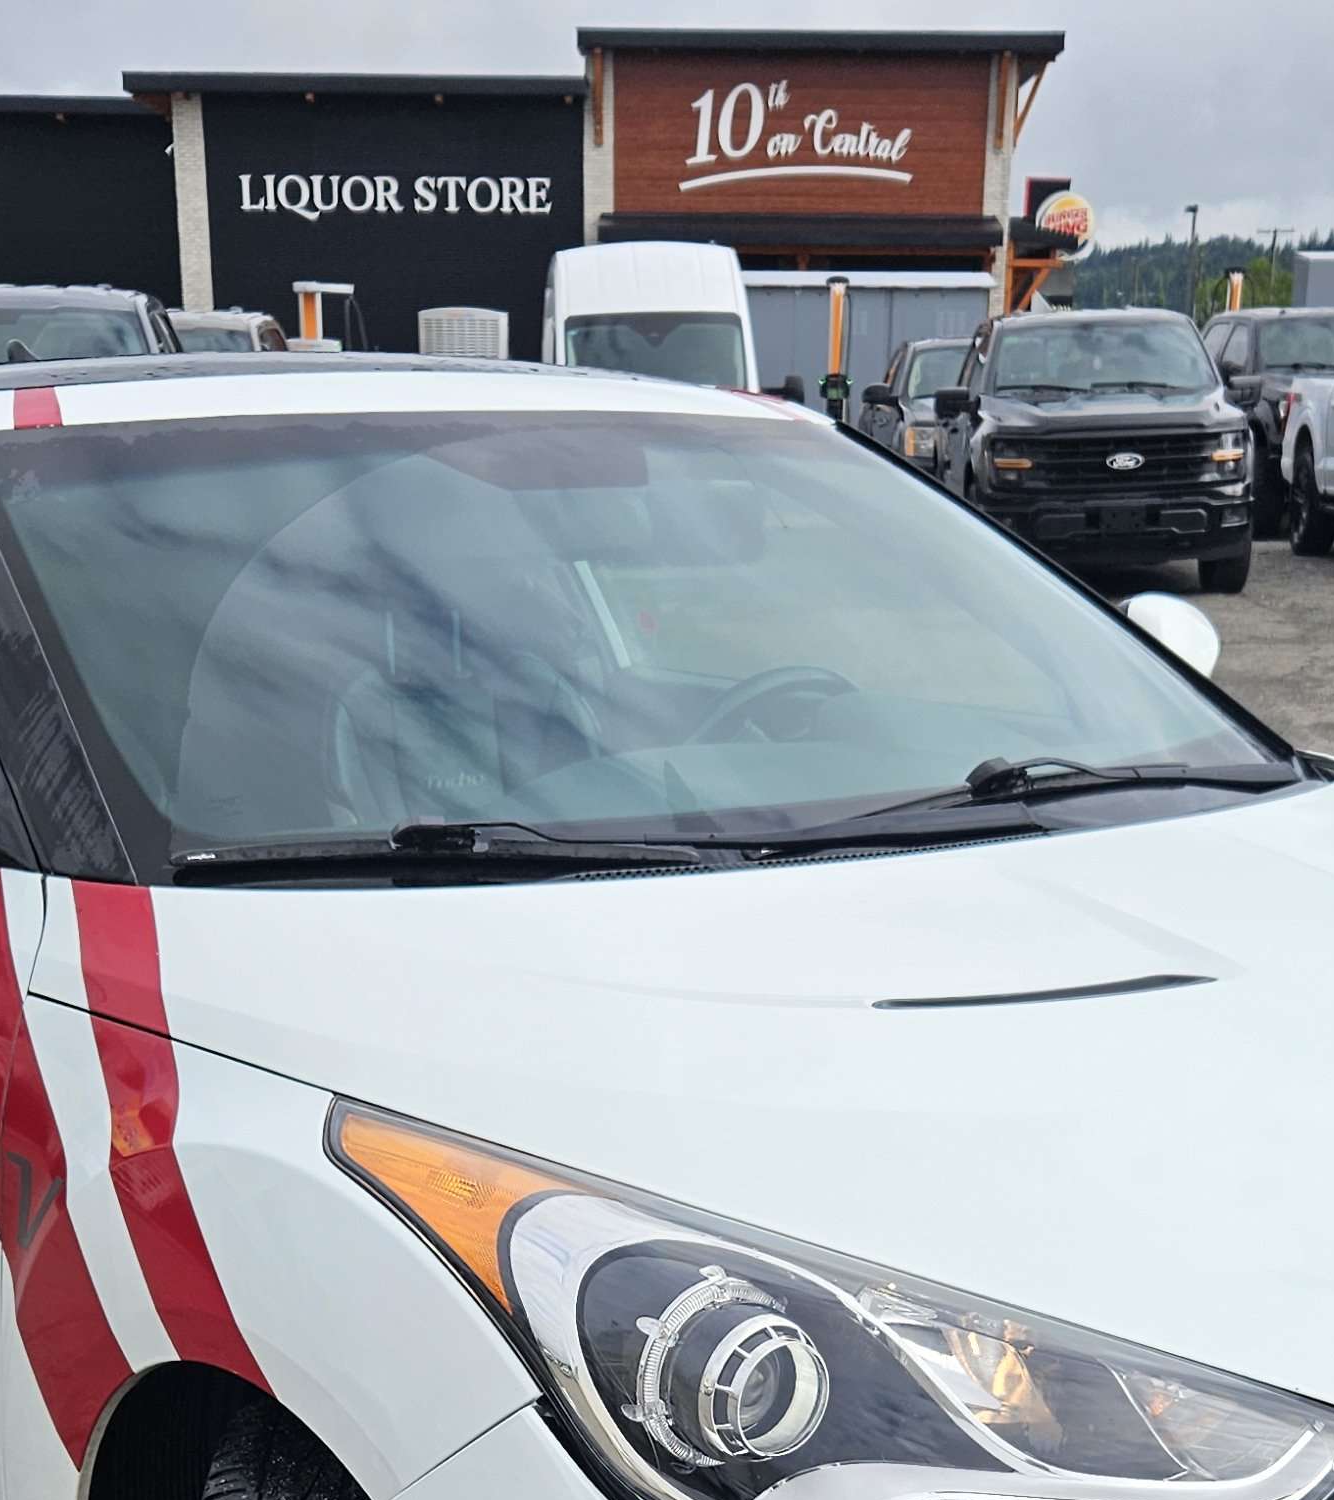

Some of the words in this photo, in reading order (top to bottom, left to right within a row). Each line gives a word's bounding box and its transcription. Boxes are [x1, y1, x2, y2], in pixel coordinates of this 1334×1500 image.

[767, 132, 802, 158] on
[803, 109, 913, 164] Central
[238, 173, 405, 221] LIQUOR
[413, 175, 553, 214] STORE
